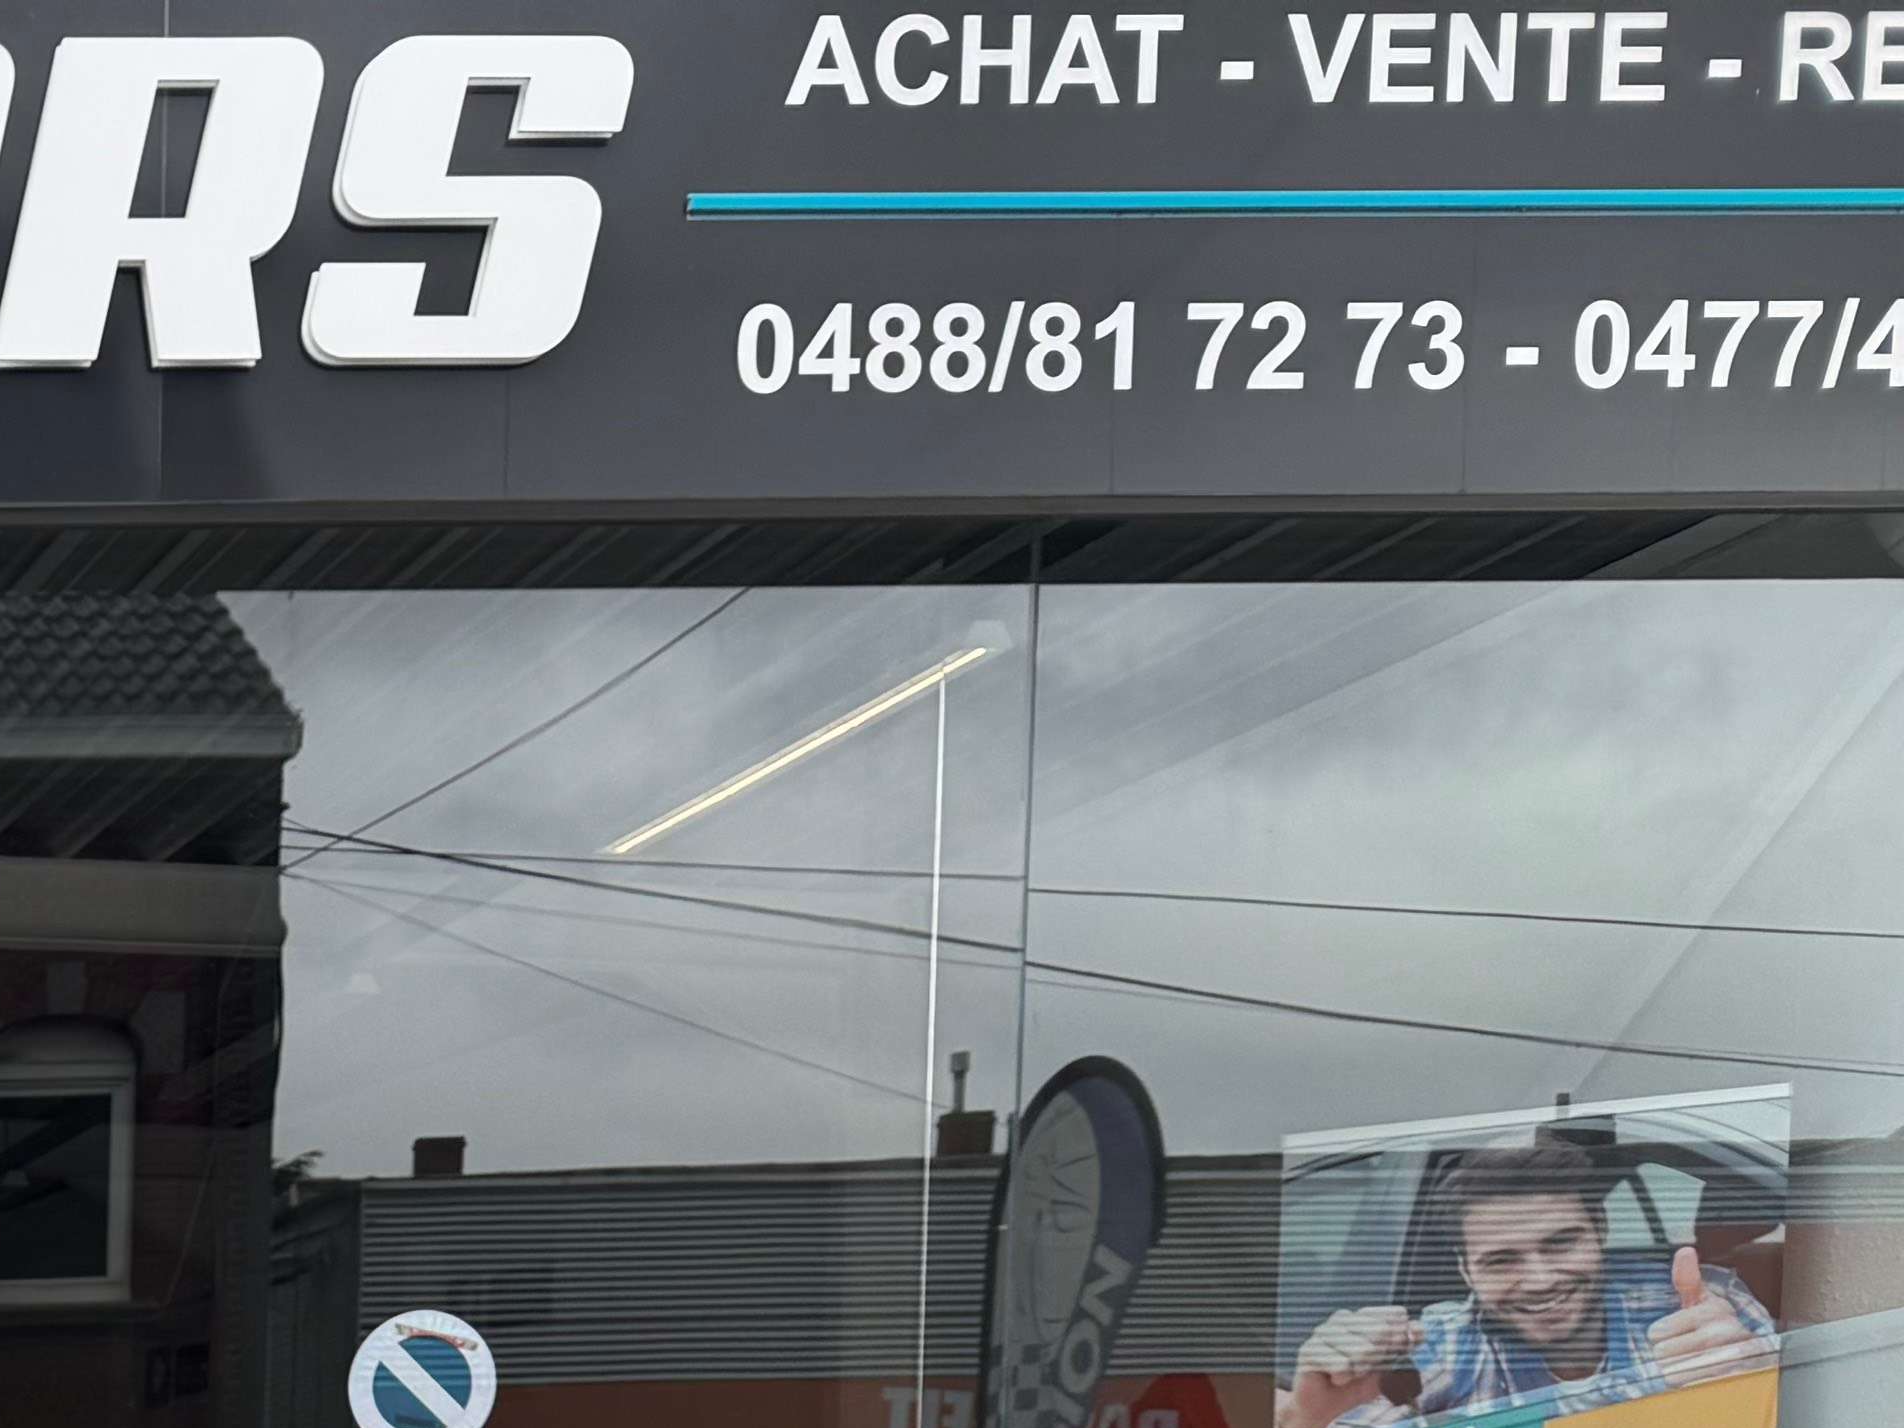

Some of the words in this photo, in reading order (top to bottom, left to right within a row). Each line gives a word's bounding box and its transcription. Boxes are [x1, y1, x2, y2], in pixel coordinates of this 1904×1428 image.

[784, 12, 1184, 108] ACHAT
[1219, 59, 1255, 80] -
[1291, 10, 1667, 105] VENTE
[1708, 57, 1743, 79] -
[737, 300, 1135, 395] 0488/81
[1184, 301, 1305, 392] 72
[1347, 299, 1467, 391] 73
[1504, 346, 1541, 366] -
